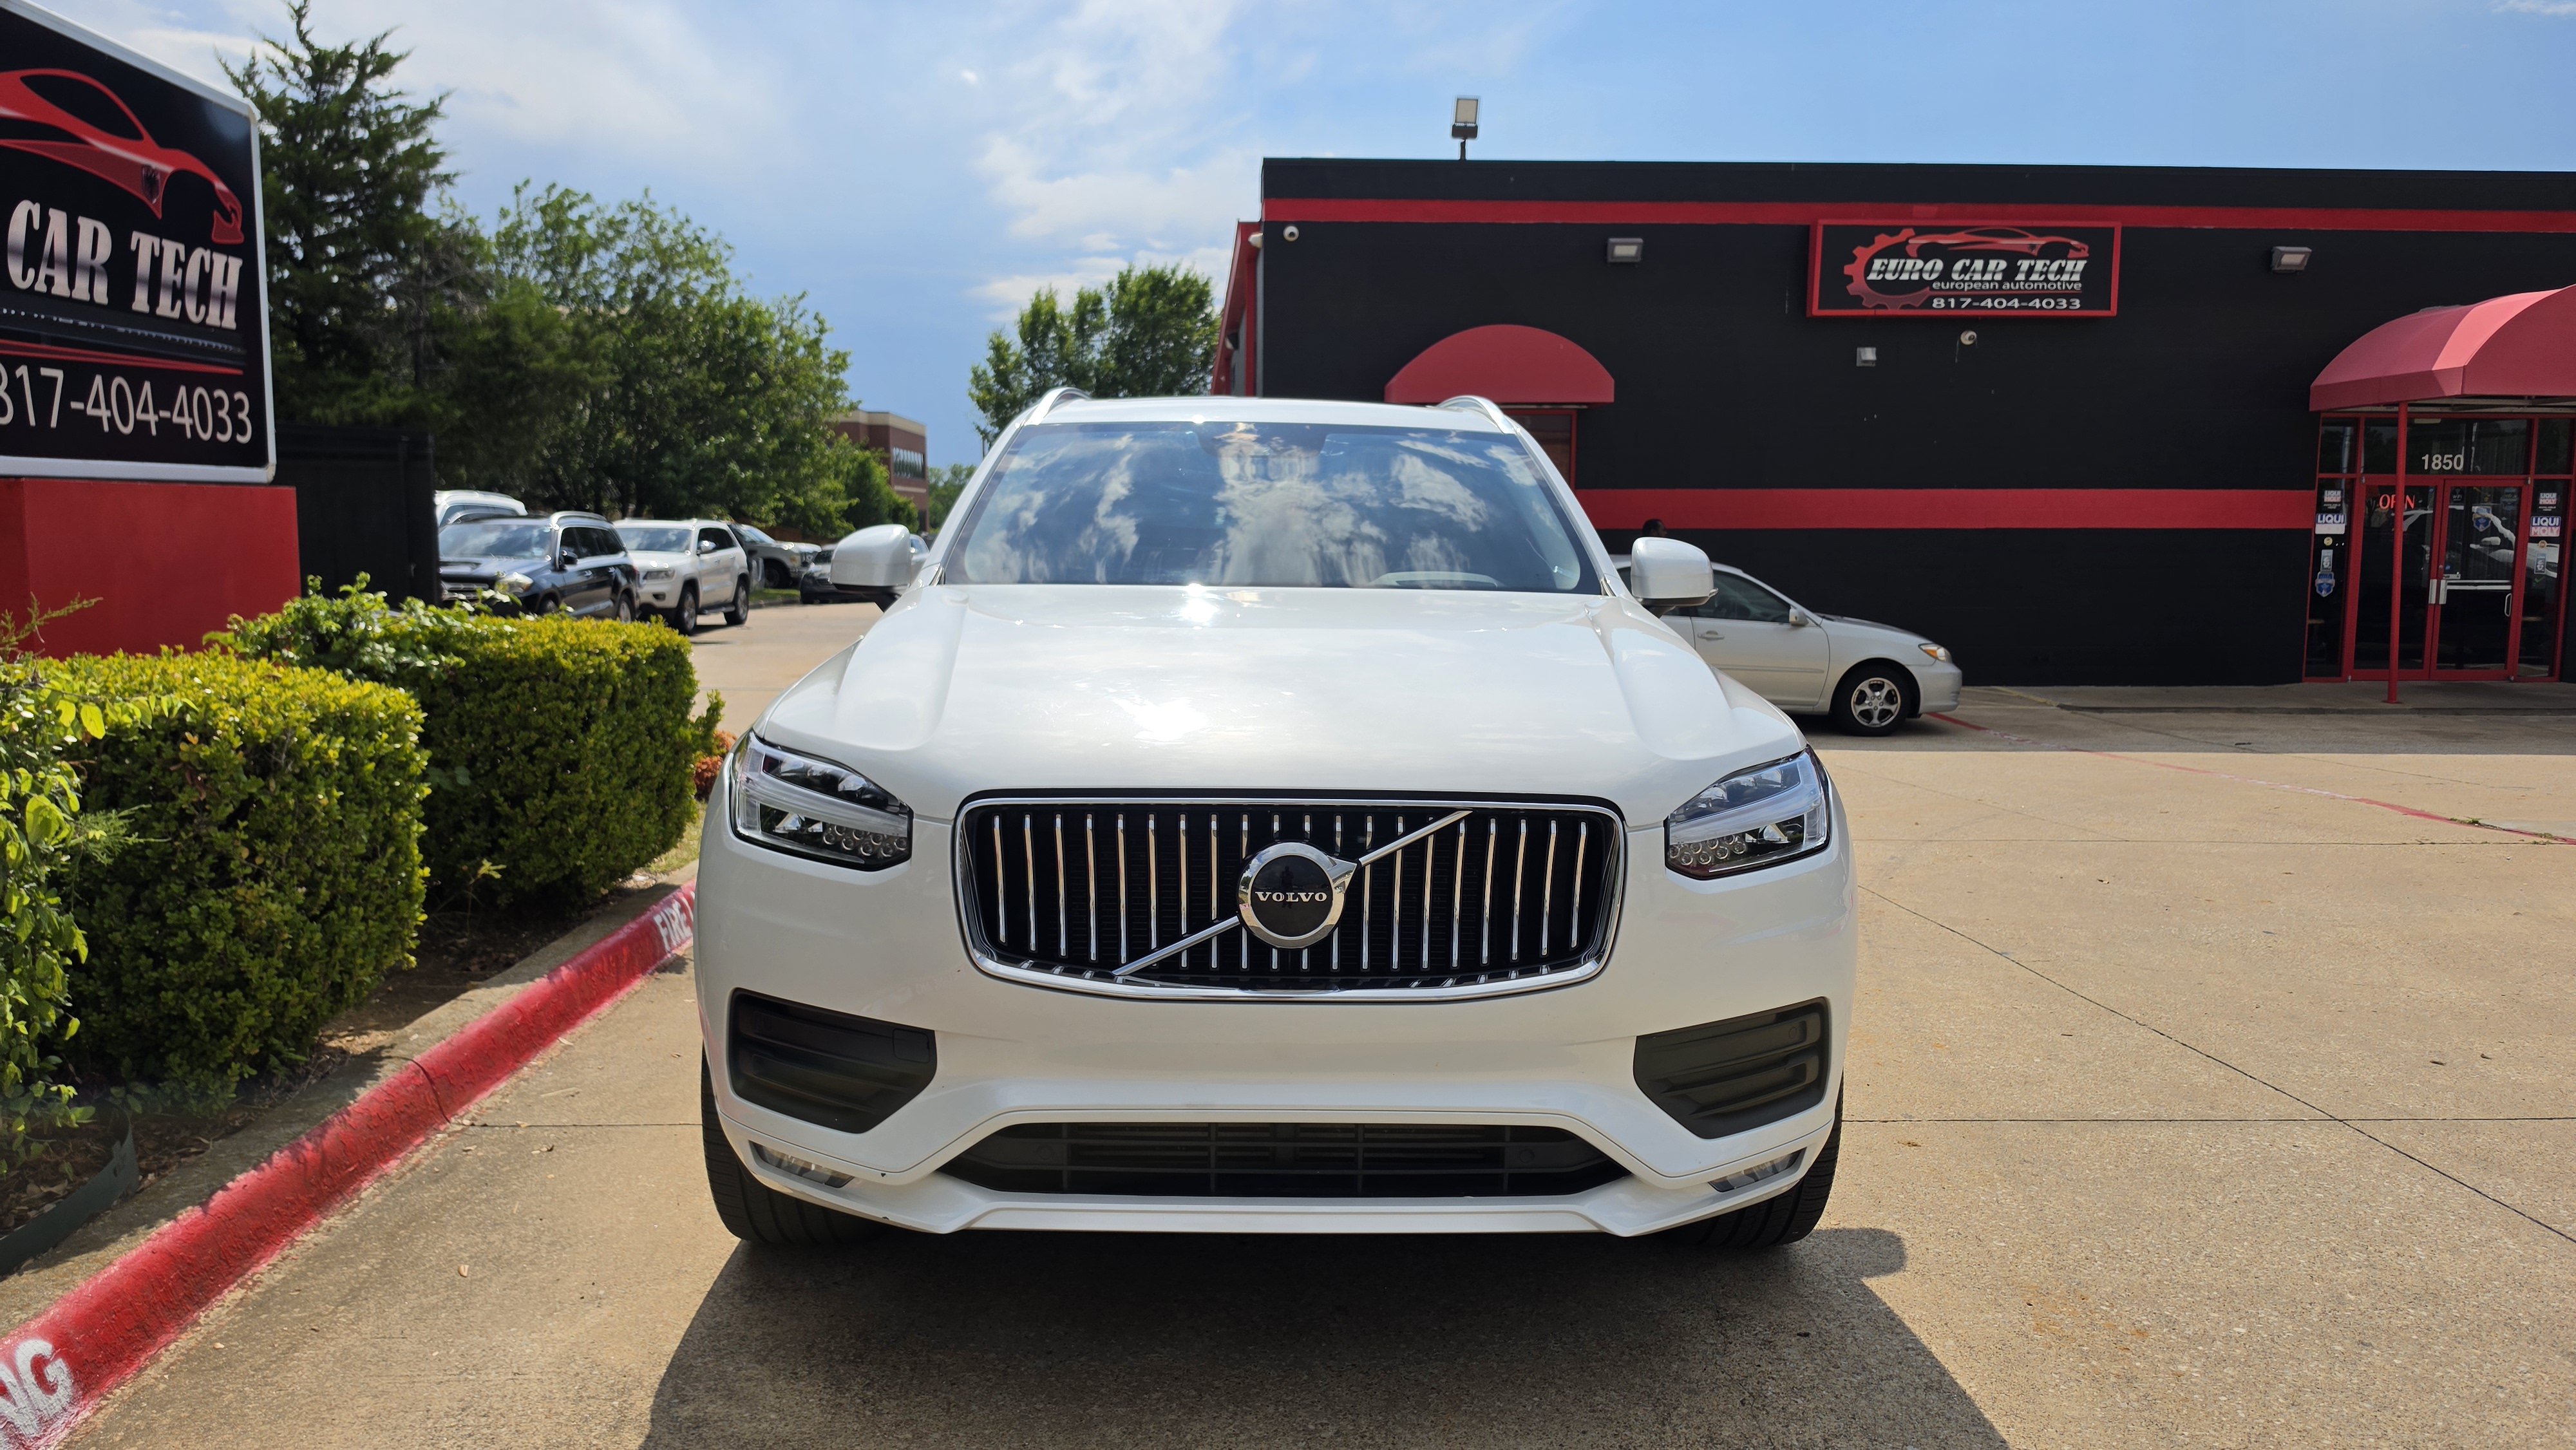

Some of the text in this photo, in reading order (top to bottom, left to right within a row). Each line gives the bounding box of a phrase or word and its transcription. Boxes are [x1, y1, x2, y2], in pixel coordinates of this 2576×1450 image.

[7, 199, 243, 330] CAR TECH
[1866, 258, 2087, 281] EURO CAR TECH
[1932, 281, 2082, 291] european automotive
[1932, 297, 2081, 308] 817-404-4033
[2421, 454, 2464, 470] 1850
[2318, 514, 2344, 523] LIQUI
[2532, 517, 2559, 526] LIQUI
[2531, 527, 2559, 536] MOLY
[1255, 891, 1327, 902] VOLVO
[652, 898, 693, 953] FIRE
